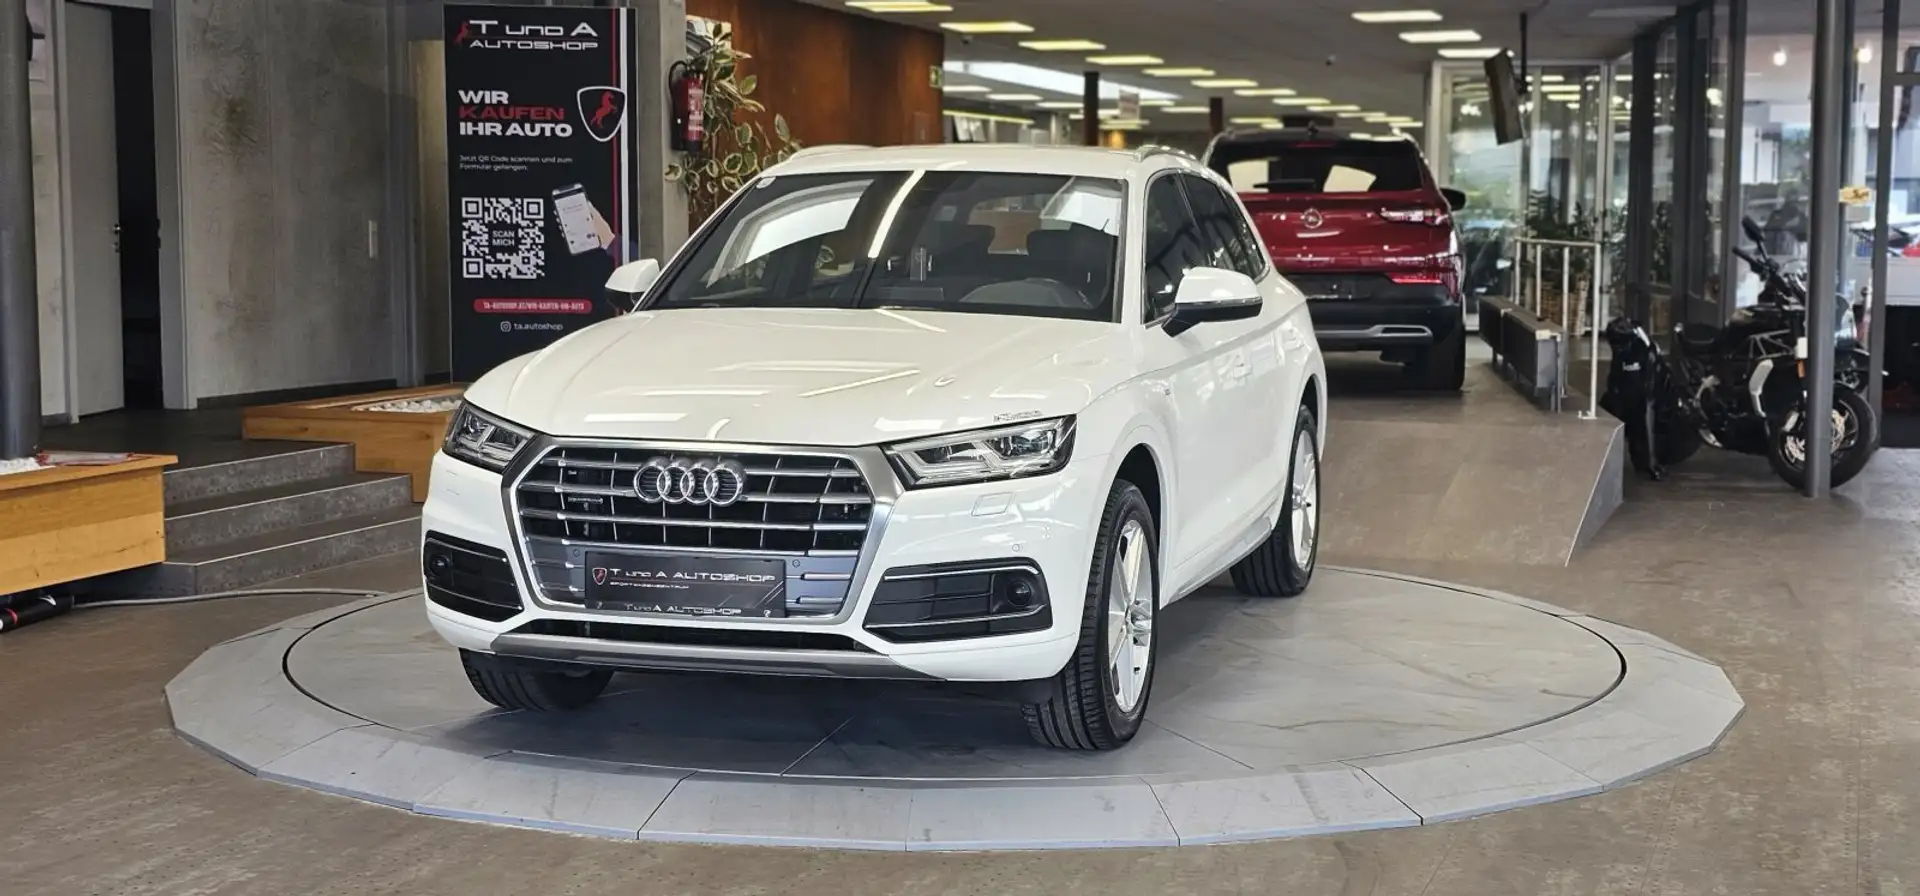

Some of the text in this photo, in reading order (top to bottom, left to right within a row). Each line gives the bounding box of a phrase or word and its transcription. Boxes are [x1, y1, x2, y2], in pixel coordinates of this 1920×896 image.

[469, 20, 498, 34] T
[570, 22, 599, 37] A
[469, 39, 599, 50] AUTOSHOP
[458, 90, 509, 105] WIR
[459, 105, 565, 121] KAUFEN
[459, 122, 573, 137] IHR AUTO
[490, 155, 509, 163] Code
[541, 156, 556, 164] und
[492, 230, 515, 238] SCAN
[513, 322, 564, 331] ta.autoshop
[609, 568, 622, 576] T
[656, 570, 668, 578] A
[673, 571, 776, 582] AUTOSHOP
[624, 603, 634, 611] T
[652, 604, 662, 612] A
